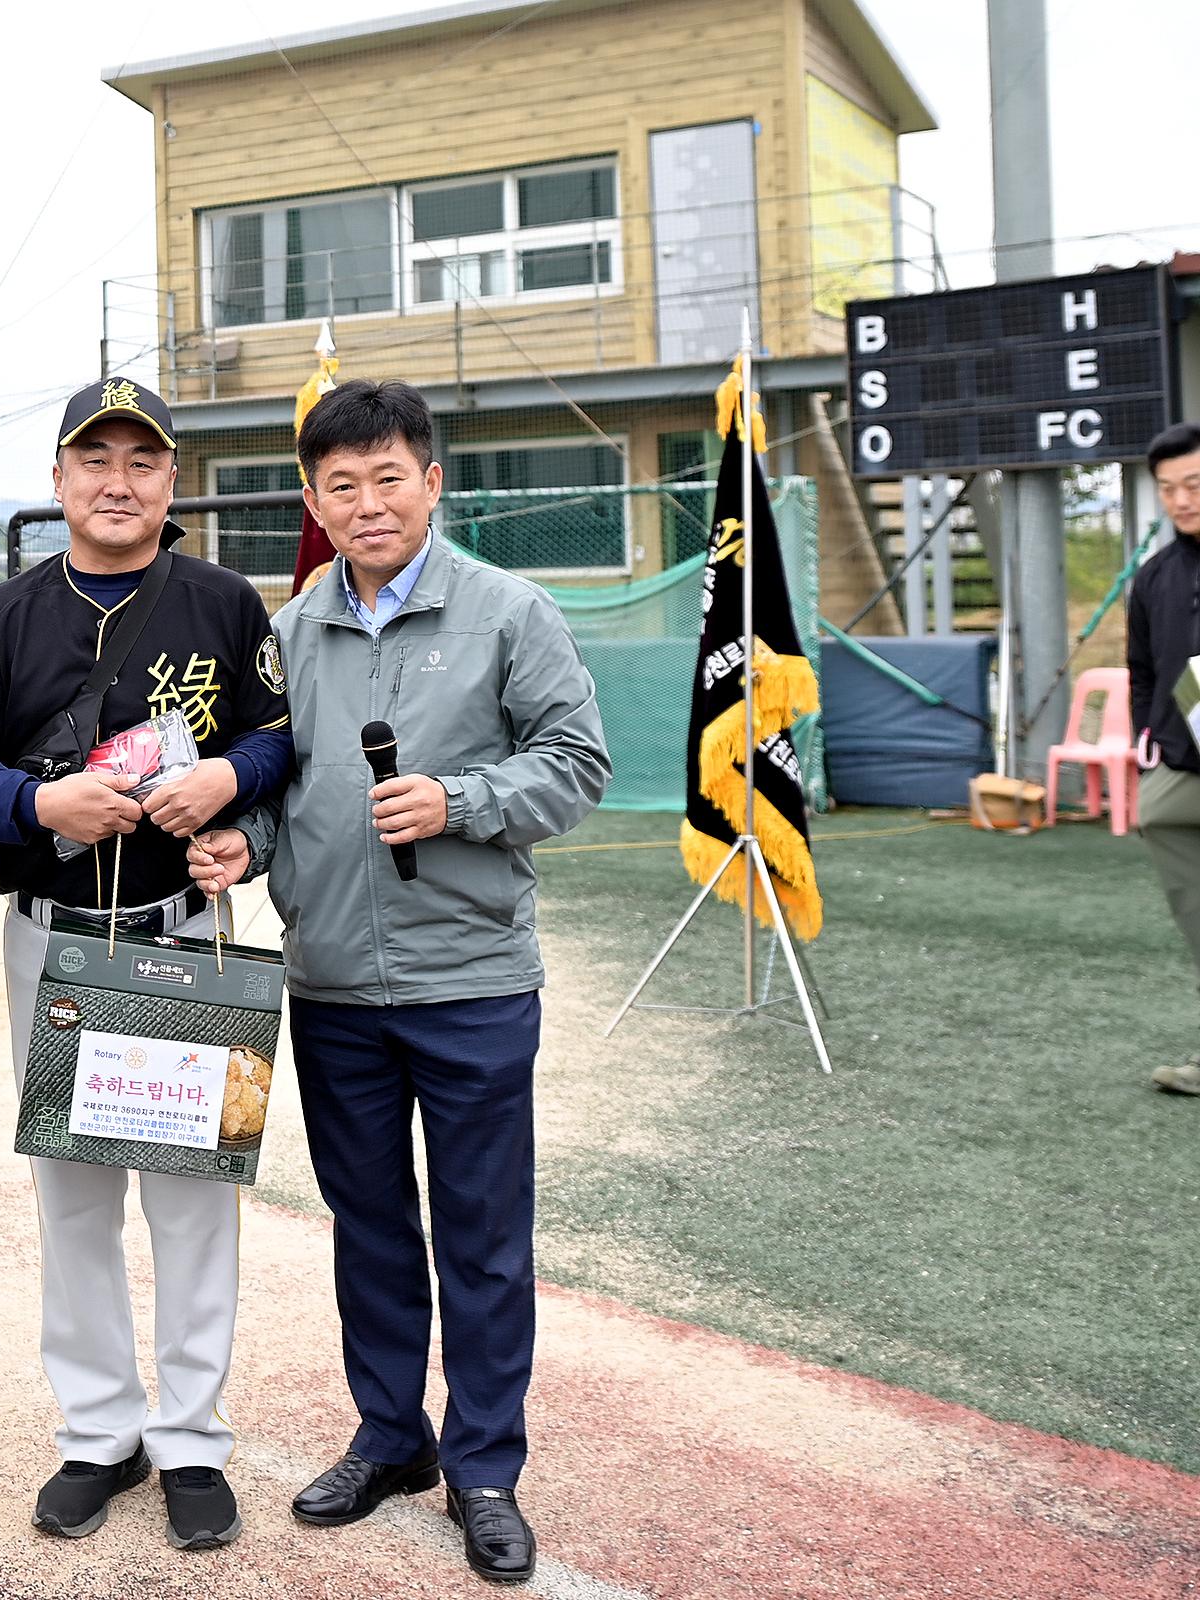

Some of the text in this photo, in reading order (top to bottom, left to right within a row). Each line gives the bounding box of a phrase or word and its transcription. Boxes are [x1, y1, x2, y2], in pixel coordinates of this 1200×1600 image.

[1063, 289, 1098, 332] H
[855, 315, 888, 353] B
[1067, 349, 1100, 392] E
[858, 370, 889, 409] S
[859, 425, 892, 463] O
[1037, 409, 1103, 450] FC
[60, 954, 83, 965] RICE
[48, 1006, 78, 1021] RICE
[94, 1049, 122, 1061] Rotary
[85, 1073, 209, 1107] 축하드립니다.
[121, 1105, 155, 1117] 3690지구
[217, 1155, 230, 1170] C
